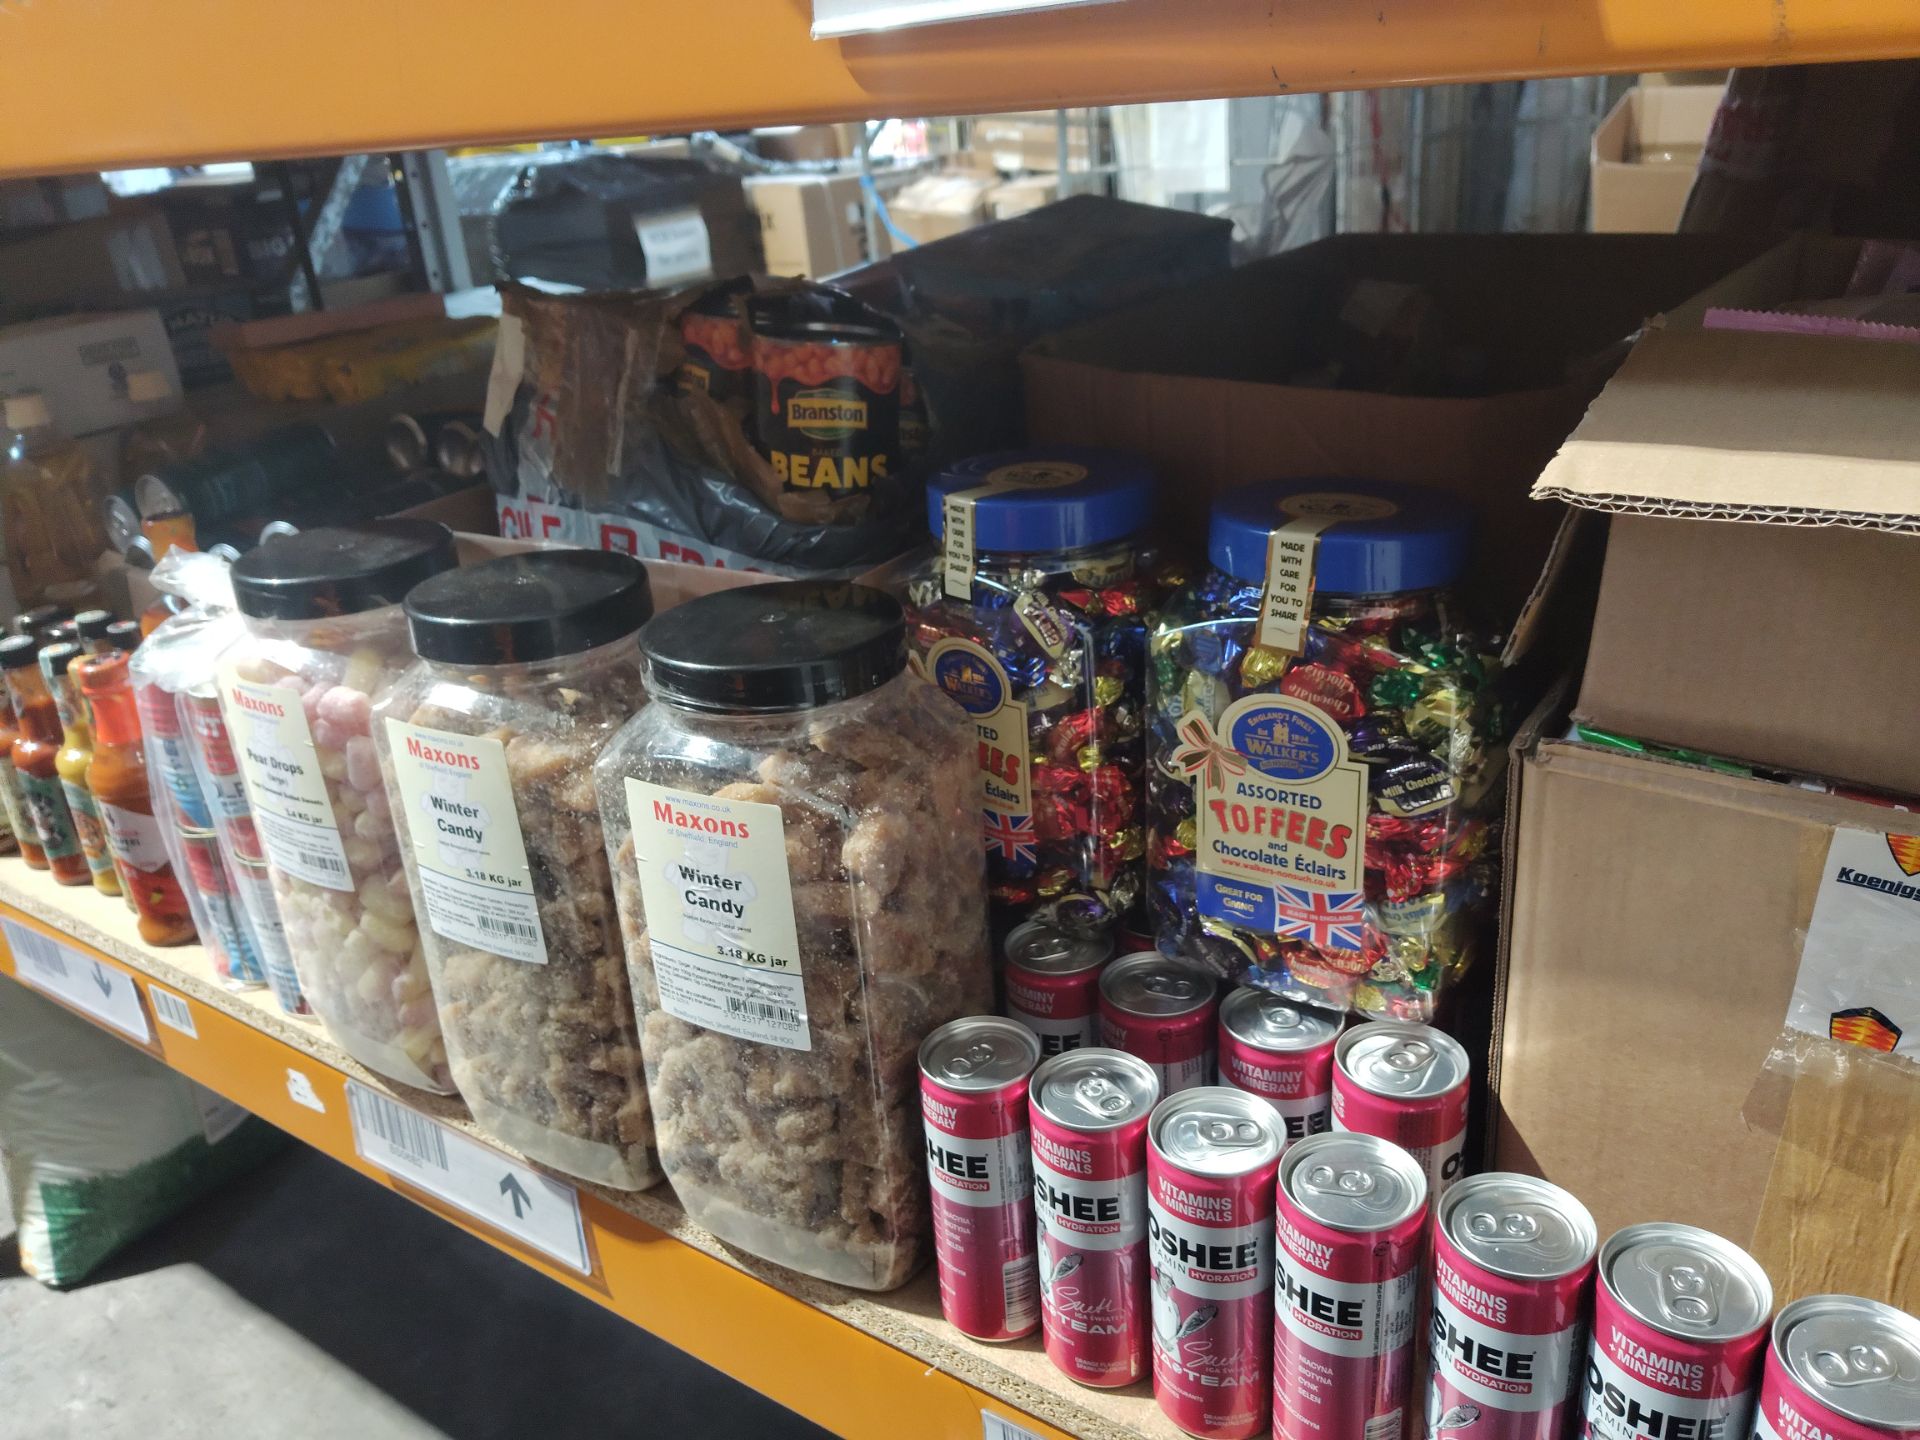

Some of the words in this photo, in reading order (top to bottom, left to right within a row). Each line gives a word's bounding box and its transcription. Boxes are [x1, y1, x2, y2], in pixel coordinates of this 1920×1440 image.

[792, 403, 864, 422] Branston
[770, 450, 889, 488] BEANS
[951, 517, 965, 525] WITH
[949, 551, 961, 560] YOU
[962, 554, 971, 562] TO
[953, 540, 964, 549] FOR
[1280, 541, 1305, 553] MADE
[1280, 555, 1302, 567] WITH
[1279, 568, 1300, 580] CARE
[1280, 582, 1297, 593] FOR
[1270, 593, 1289, 605] YOU
[1290, 597, 1303, 608] TO
[1271, 610, 1297, 622] SHARE
[232, 688, 285, 717] Maxons
[1289, 684, 1350, 714] Chocolate
[247, 747, 267, 767] Pear
[270, 757, 304, 776] Drops
[407, 736, 480, 770] Maxons
[1246, 738, 1319, 764] WALKER'S
[985, 780, 1020, 804] Éclairs
[1236, 782, 1322, 810] ASSORTED
[1382, 784, 1405, 797] Milk
[430, 795, 479, 818] Winter
[437, 818, 483, 843] Candy
[653, 800, 750, 839] Maxons
[1209, 800, 1352, 859] TOFFEES
[708, 836, 738, 848] England
[1267, 841, 1288, 852] and
[1212, 839, 1288, 868] Chocolate
[1295, 854, 1346, 880] Éclairs
[465, 868, 486, 881] 3.18
[489, 874, 505, 884] KG
[508, 877, 522, 887] jar
[678, 864, 742, 891] Winter
[685, 890, 744, 918] Candy
[1215, 884, 1243, 898] GREAT
[1245, 891, 1263, 902] FOR
[1223, 897, 1254, 912] GIVING
[717, 946, 742, 959] 3.18
[747, 951, 766, 963] KG
[770, 956, 788, 967] jar
[1231, 1055, 1303, 1082] WITAMINY
[1032, 1124, 1092, 1163] VITAMINS
[935, 1169, 988, 1190] HYDRATION
[1035, 1175, 1120, 1222] SHEE
[1159, 1176, 1232, 1211] VITAMINS
[1057, 1215, 1119, 1233] HYDRATION
[1148, 1208, 1258, 1270] OSHEE
[1191, 1269, 1256, 1282] HYDRATION
[1437, 1252, 1508, 1312] VITAMINS
[1057, 1311, 1128, 1335] TEAM
[1294, 1311, 1360, 1340] HYDRATION
[1433, 1306, 1534, 1380] SHEE
[1611, 1325, 1705, 1379] VITAMINS
[1183, 1368, 1260, 1387] TEAM
[1298, 1365, 1332, 1386] BIOTYNA
[1299, 1355, 1334, 1376] NIACYNA
[1617, 1347, 1702, 1392] MINERALS
[1298, 1376, 1318, 1393] CYNK
[1456, 1364, 1528, 1393] HYDRATION
[1298, 1387, 1321, 1404] SELEN
[1587, 1355, 1730, 1440] OSHEE
[1591, 1395, 1633, 1440] TAMIN
